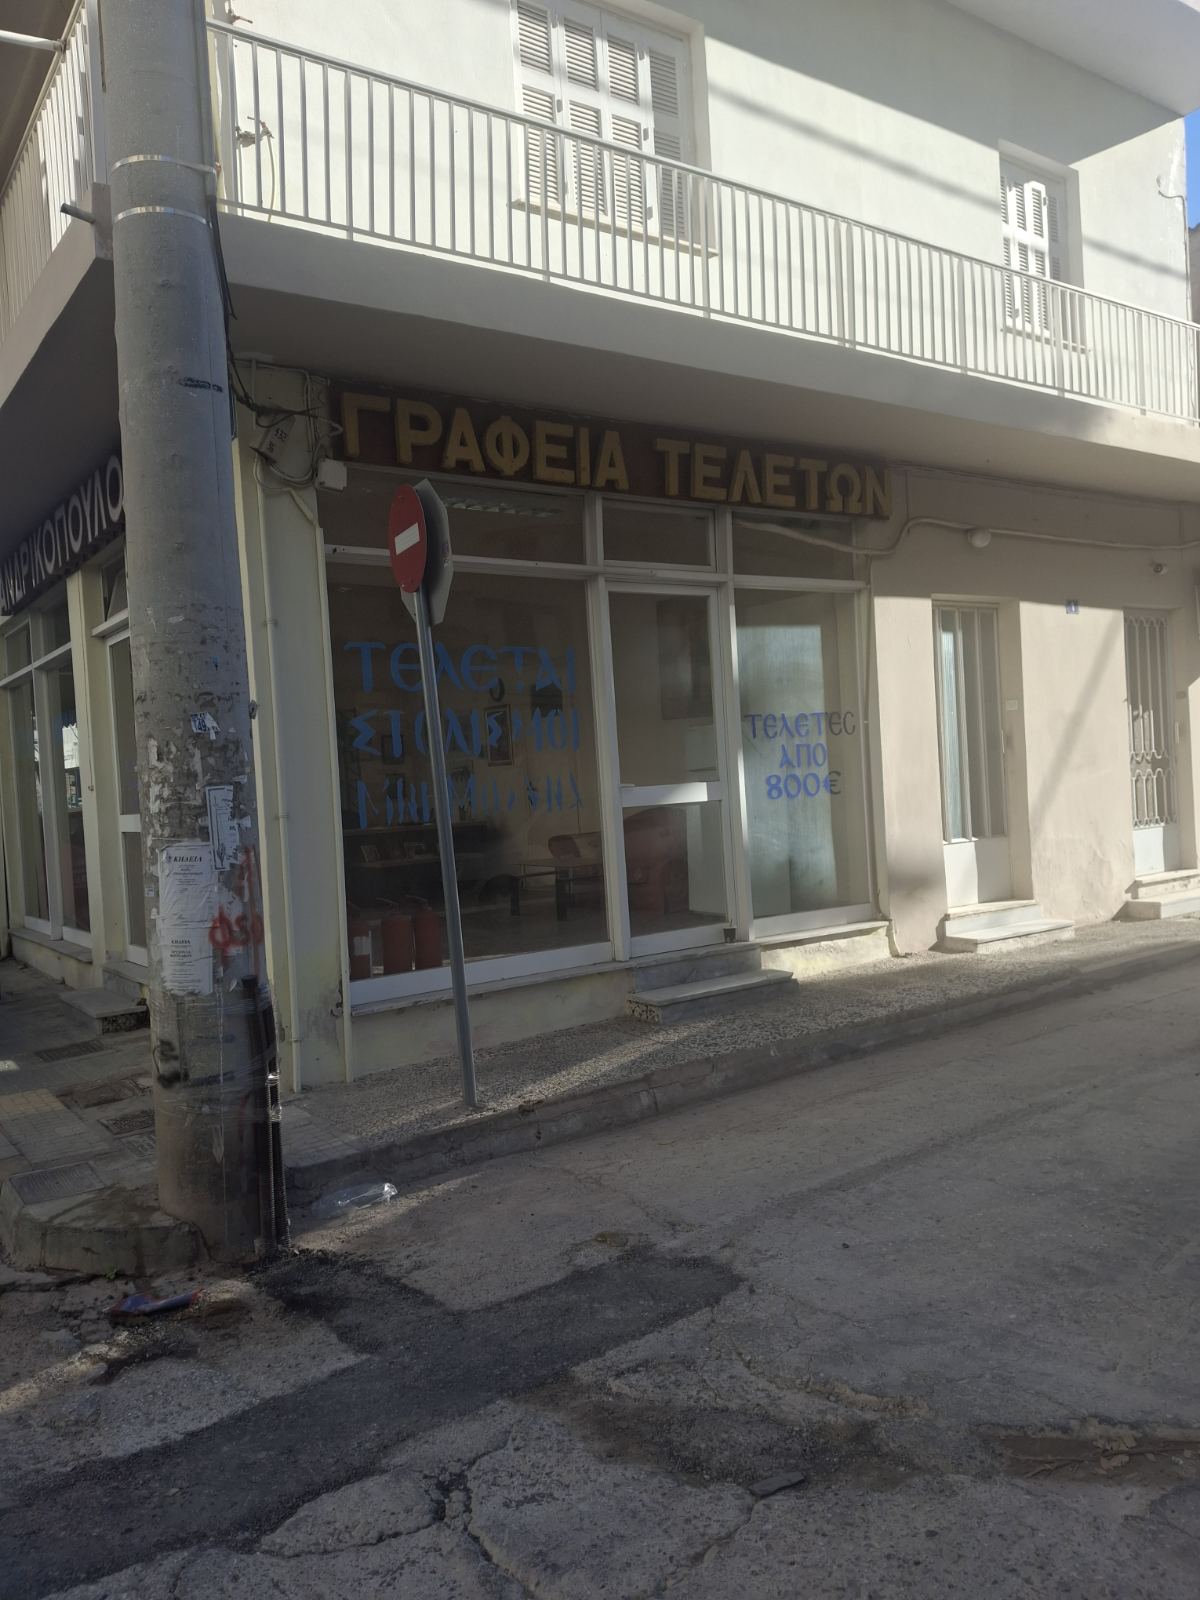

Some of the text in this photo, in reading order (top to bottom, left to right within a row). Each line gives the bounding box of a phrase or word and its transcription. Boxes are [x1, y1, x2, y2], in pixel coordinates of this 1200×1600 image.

[341, 391, 892, 516] ΓΡΑΦΕΙΑ ΤΕΛΕΤΩΝ
[344, 640, 577, 694] ΤΕΛΕΤΑΙ
[779, 742, 827, 769] ΑΠΟ
[765, 770, 842, 800] 800€
